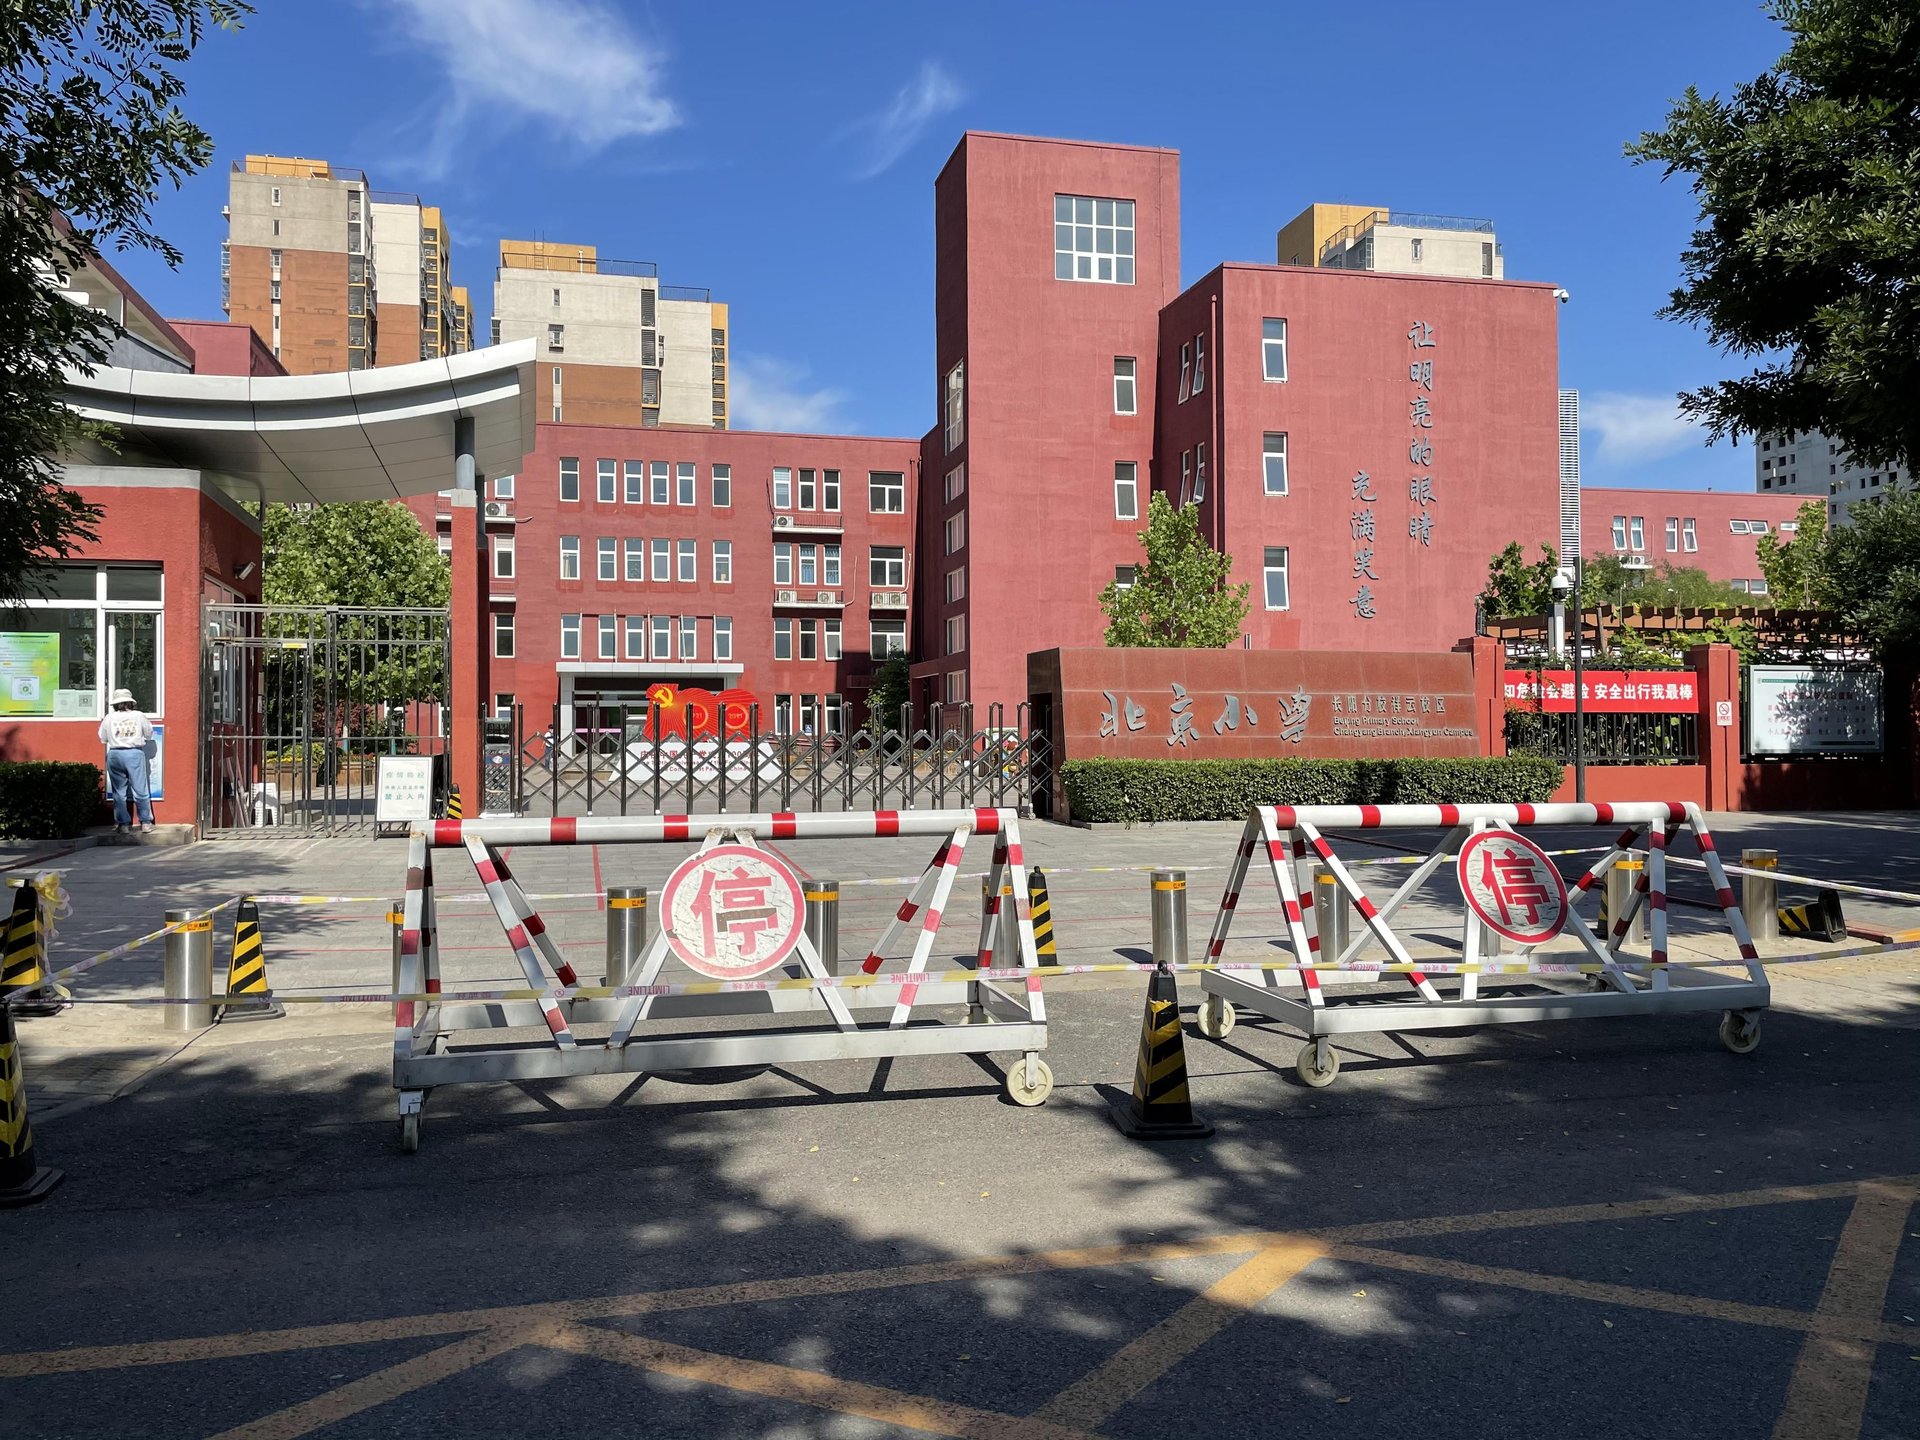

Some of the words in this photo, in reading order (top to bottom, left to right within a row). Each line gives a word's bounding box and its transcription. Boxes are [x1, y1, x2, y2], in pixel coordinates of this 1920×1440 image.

[1407, 320, 1437, 548] 让明亮的眼睛
[1349, 469, 1380, 620] 充满笑意
[1594, 683, 1693, 700] 安全出行我最棒
[1099, 682, 1313, 744] 北京小学
[1334, 717, 1360, 726] Beijing
[1362, 717, 1390, 726] Primary
[1444, 728, 1473, 737] Campus
[1481, 848, 1550, 925] 停
[690, 866, 779, 959] 停
[1539, 964, 1569, 973] LIMITLINE
[890, 973, 930, 983] LIMITLINE
[628, 985, 671, 996] LIMITLINE
